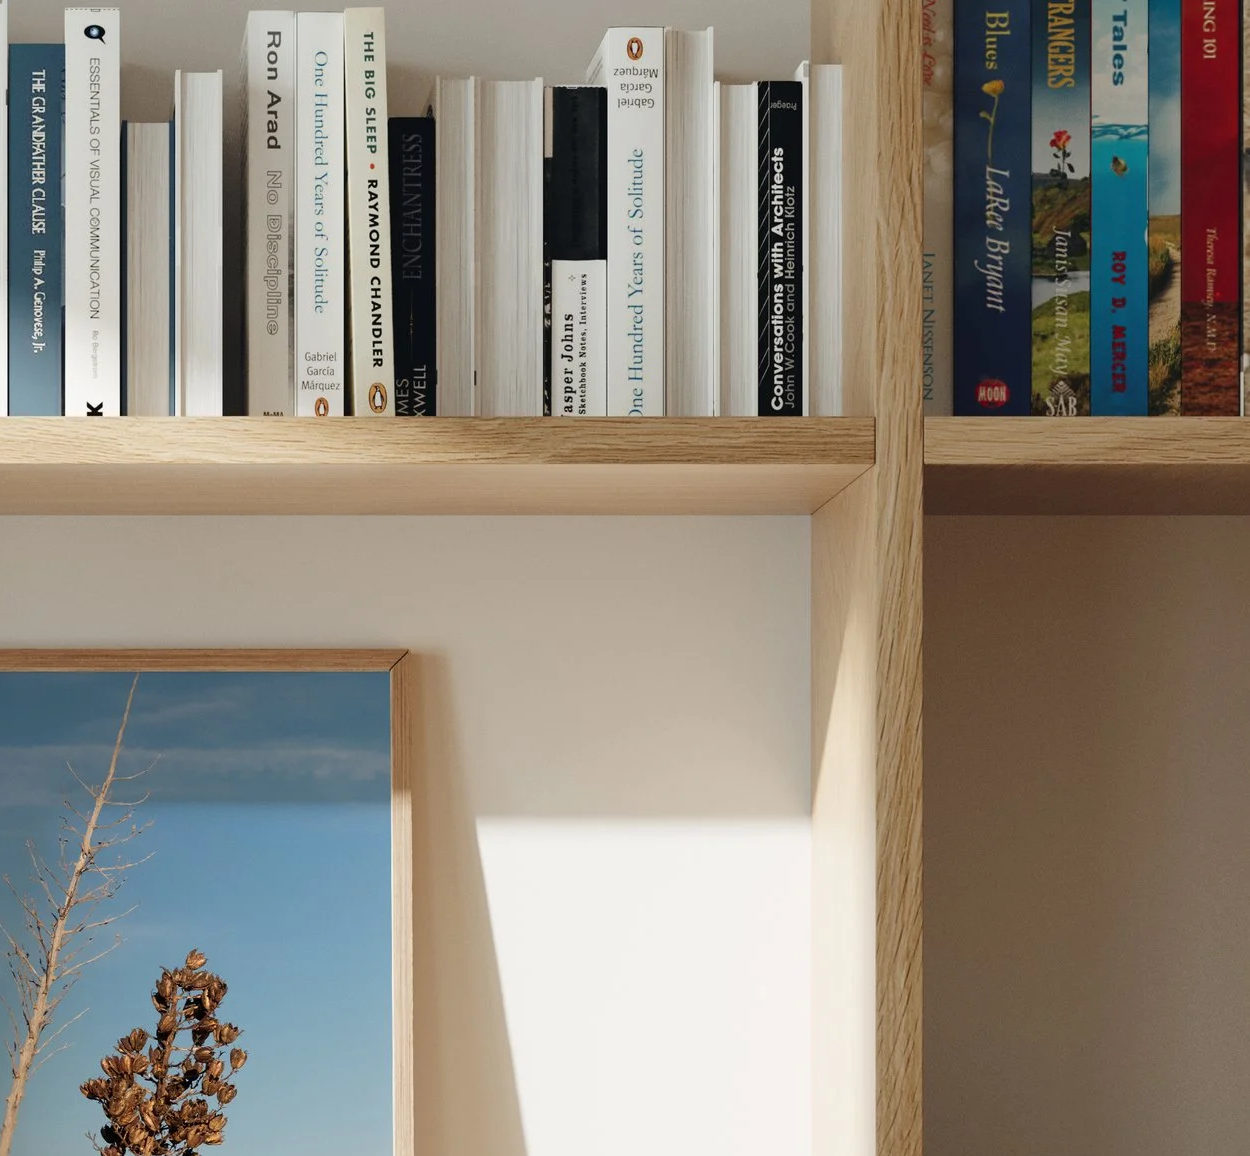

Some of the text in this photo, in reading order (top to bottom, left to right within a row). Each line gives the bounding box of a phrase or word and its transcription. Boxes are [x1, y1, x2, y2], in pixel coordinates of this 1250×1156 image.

[985, 12, 1010, 70] Blues
[1112, 11, 1128, 86] Tales
[613, 67, 659, 78] Márquez
[620, 82, 653, 93] García
[617, 97, 655, 108] Gabriel
[314, 51, 328, 314] One Hundred Years of Solitude
[785, 186, 795, 219] Klotz
[32, 70, 46, 353] THE GRANDFATHER CLAUSE Philip A. Genovese, Jr.
[975, 164, 1010, 313] LaRee Bryant
[771, 147, 784, 410] Conversations with Architects
[785, 223, 795, 280] Heinrich
[785, 285, 795, 310] and
[1050, 227, 1073, 376] Janis Susan May
[1111, 252, 1127, 393] ROY D. MERCER
[579, 273, 588, 415] Sketchbook Notes, Interviews
[923, 253, 935, 400] JANET NISSENSON
[304, 351, 337, 362] Gabriel
[307, 365, 335, 376] García
[561, 313, 574, 416] asper Johns
[301, 379, 340, 392] Márquez
[785, 373, 795, 408] John
[978, 385, 1006, 402] MOON
